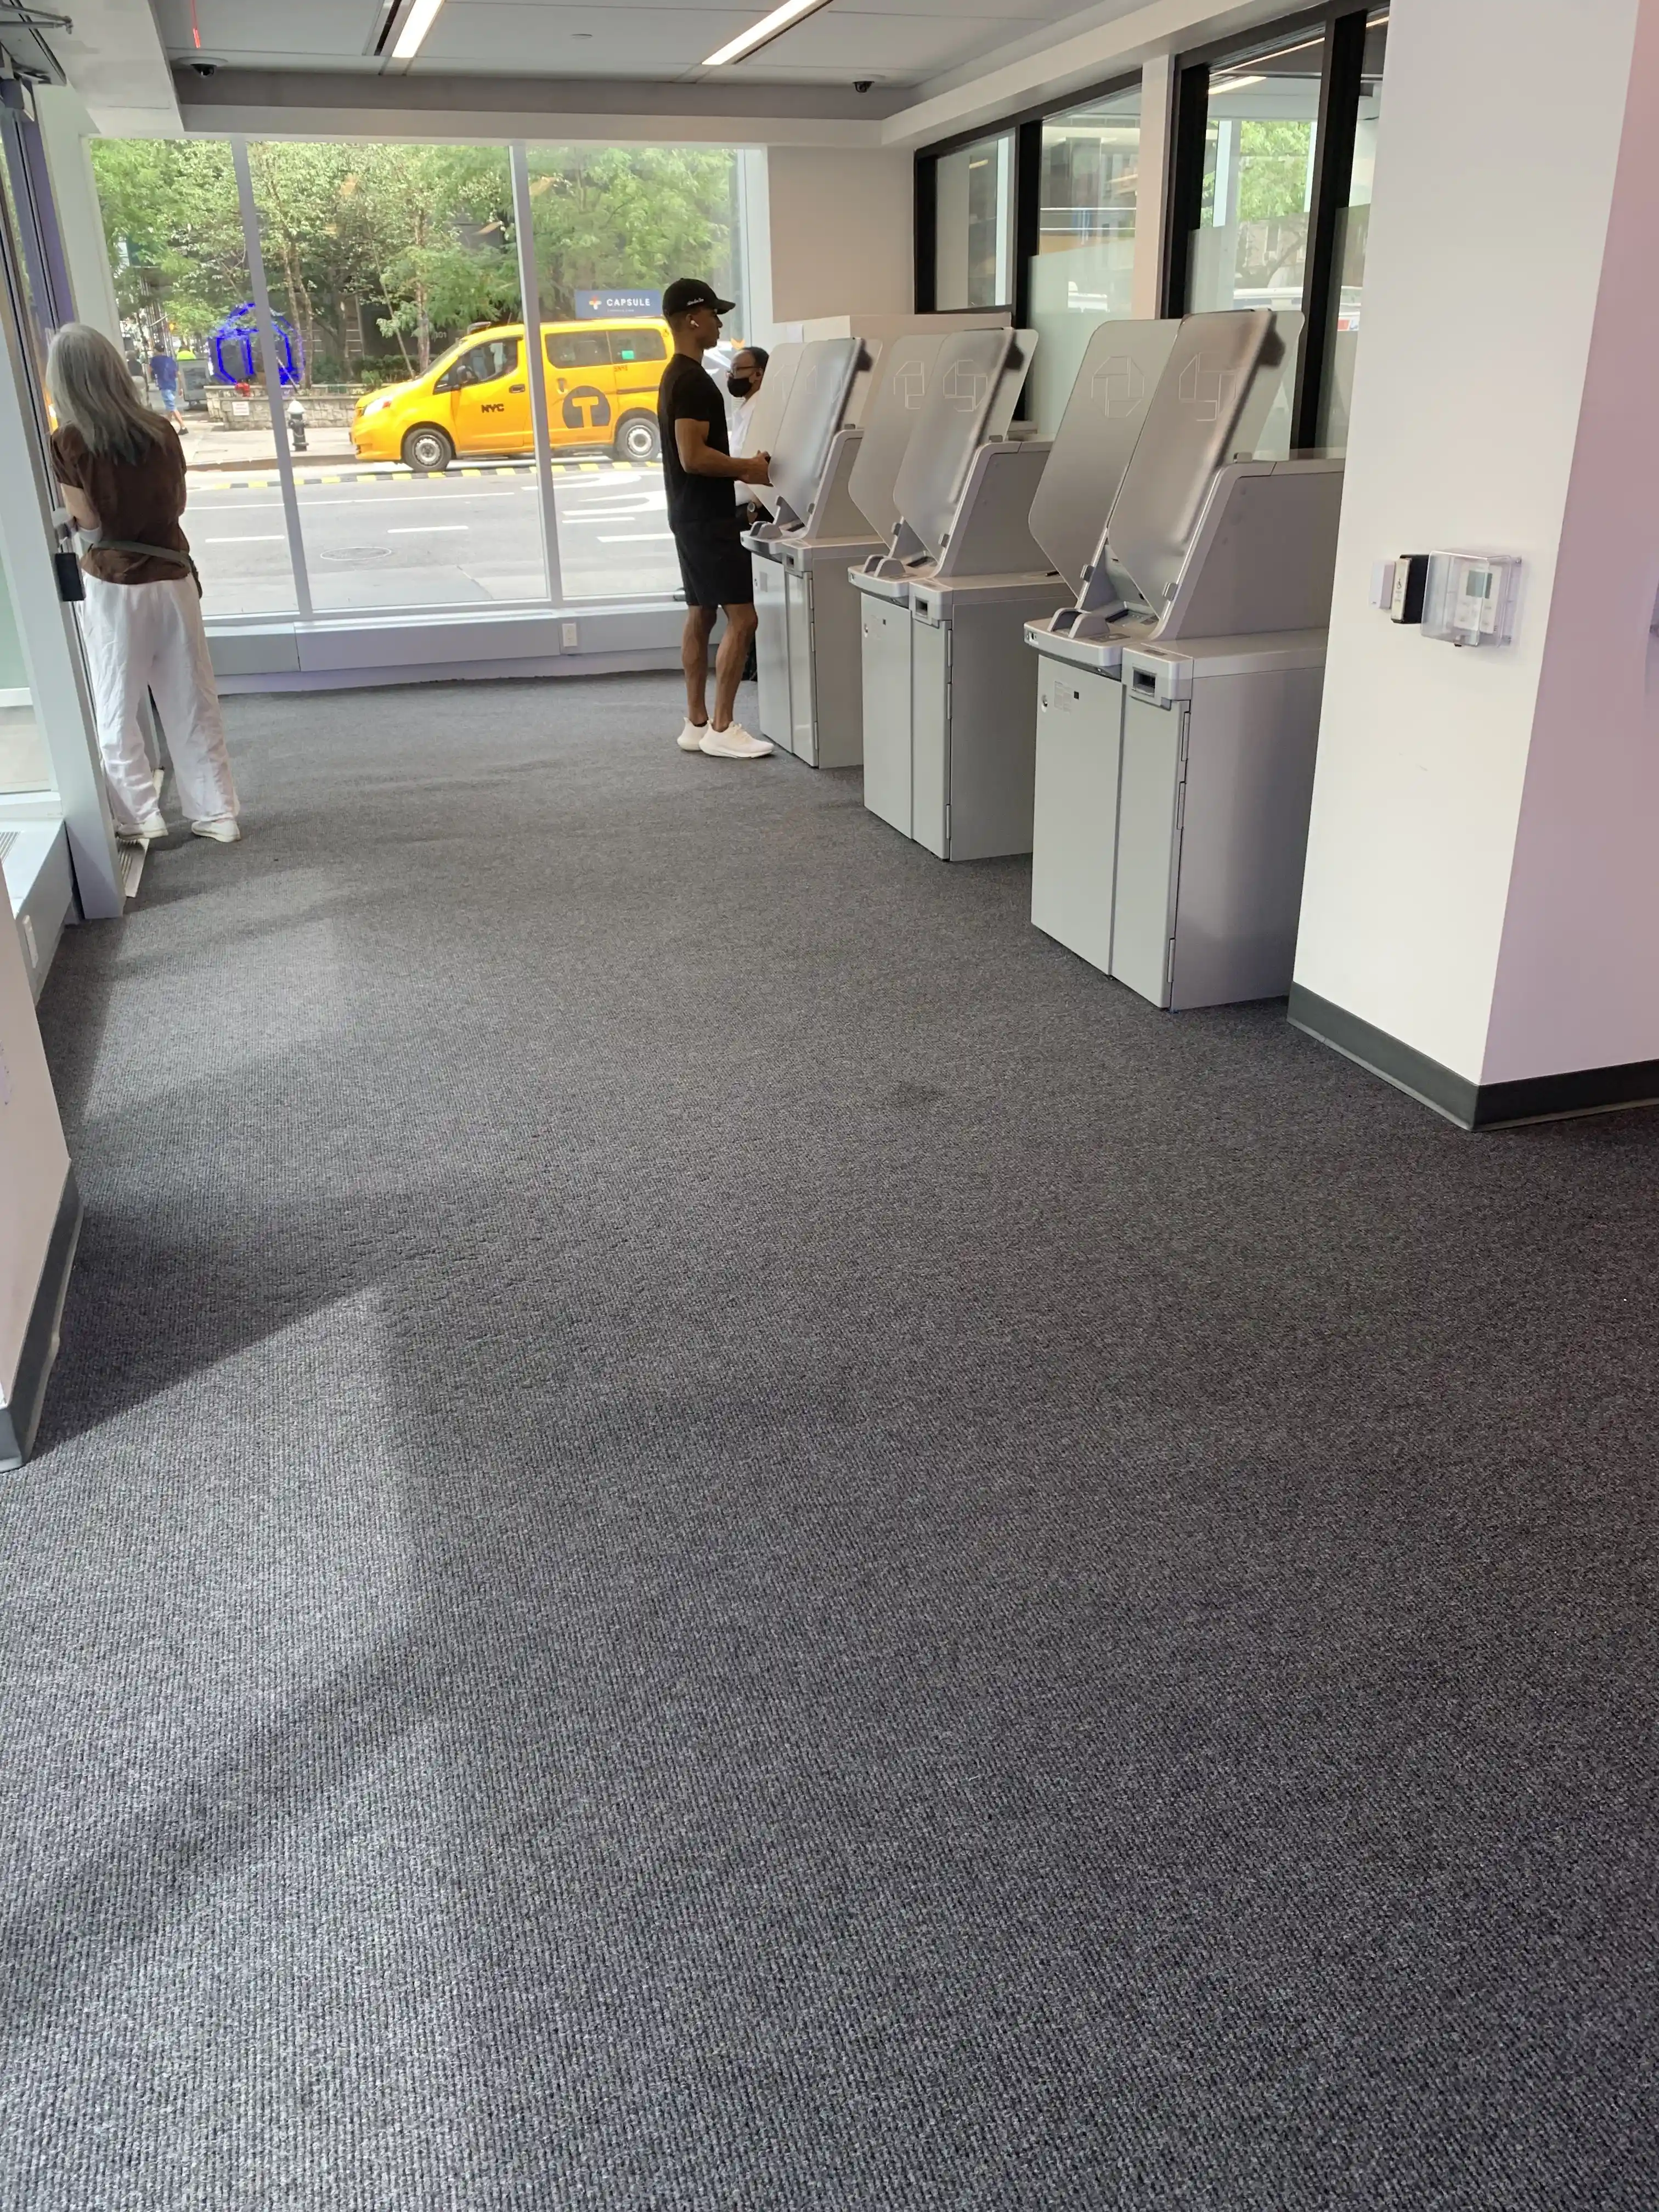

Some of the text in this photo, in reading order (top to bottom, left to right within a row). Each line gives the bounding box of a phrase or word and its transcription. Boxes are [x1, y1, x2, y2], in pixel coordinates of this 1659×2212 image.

[606, 298, 651, 306] CAPSULE
[481, 403, 505, 413] NYC
[572, 396, 599, 428] T
